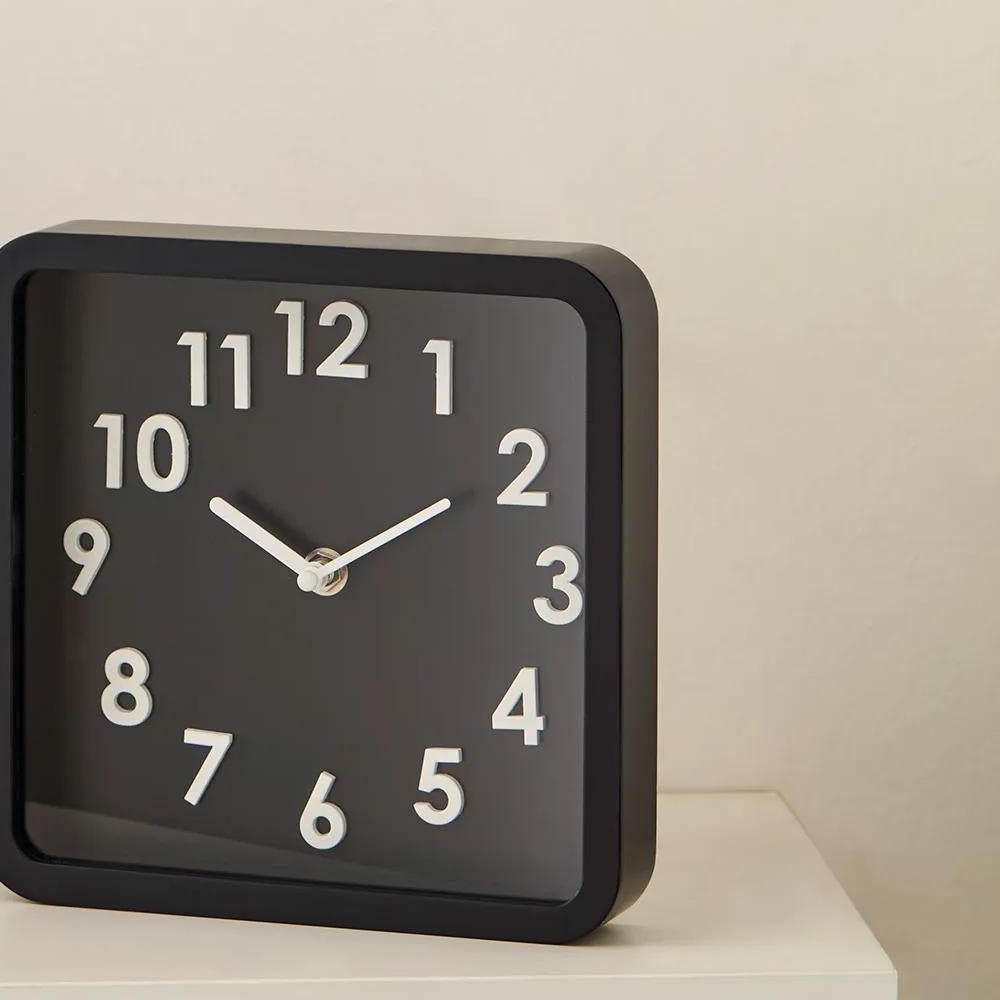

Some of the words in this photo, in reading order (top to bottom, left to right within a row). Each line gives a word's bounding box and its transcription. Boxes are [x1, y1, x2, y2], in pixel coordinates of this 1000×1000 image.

[177, 331, 253, 410] 11
[274, 300, 369, 379] 12
[423, 339, 454, 415] 1
[94, 413, 189, 493] 10
[497, 428, 550, 506] 2
[63, 517, 110, 595] 9
[534, 545, 584, 625] 3
[101, 647, 152, 727] 8
[492, 667, 546, 746] 4
[183, 729, 233, 806] 7
[413, 747, 464, 826] 5
[300, 771, 347, 850] 6
